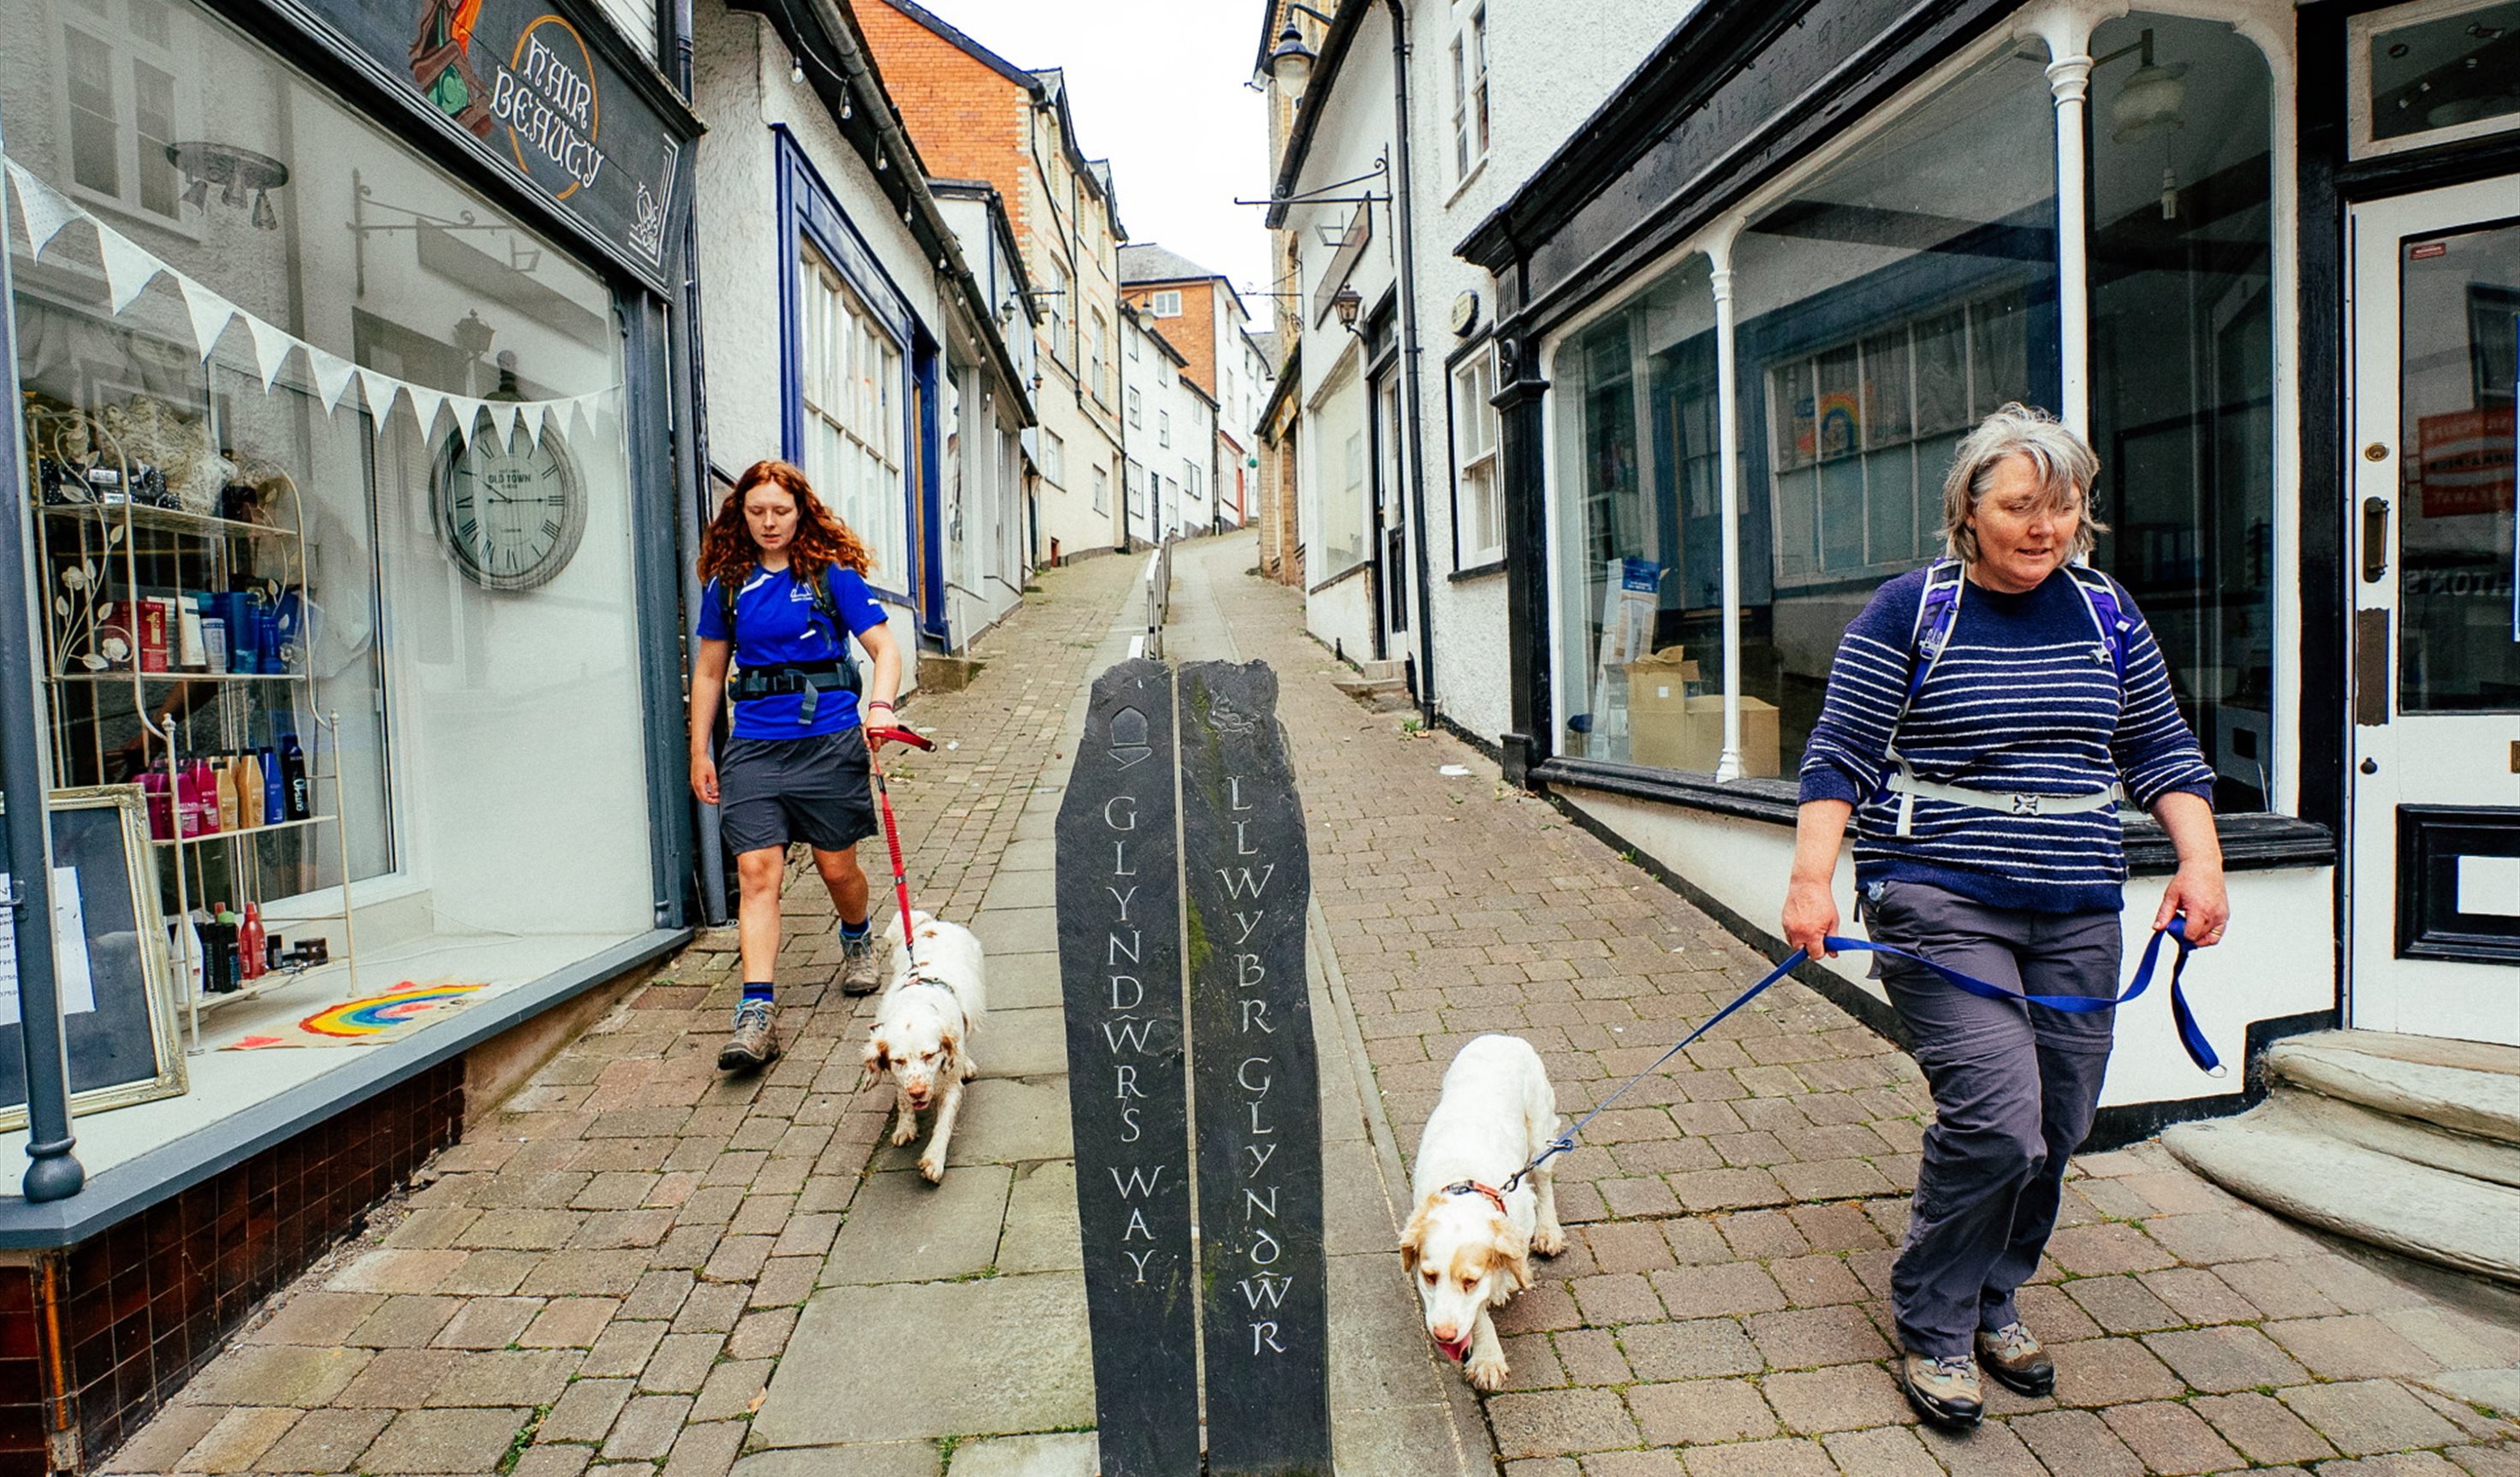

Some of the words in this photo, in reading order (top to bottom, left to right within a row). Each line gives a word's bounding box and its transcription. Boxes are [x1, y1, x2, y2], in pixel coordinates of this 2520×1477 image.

[489, 65, 604, 188] BEAUTY
[523, 33, 591, 129] HAIR
[488, 474, 504, 483] OLD
[507, 474, 531, 483] TOWN
[1215, 775, 1276, 1034] LLWYBR
[1109, 1165, 1165, 1284] WAY
